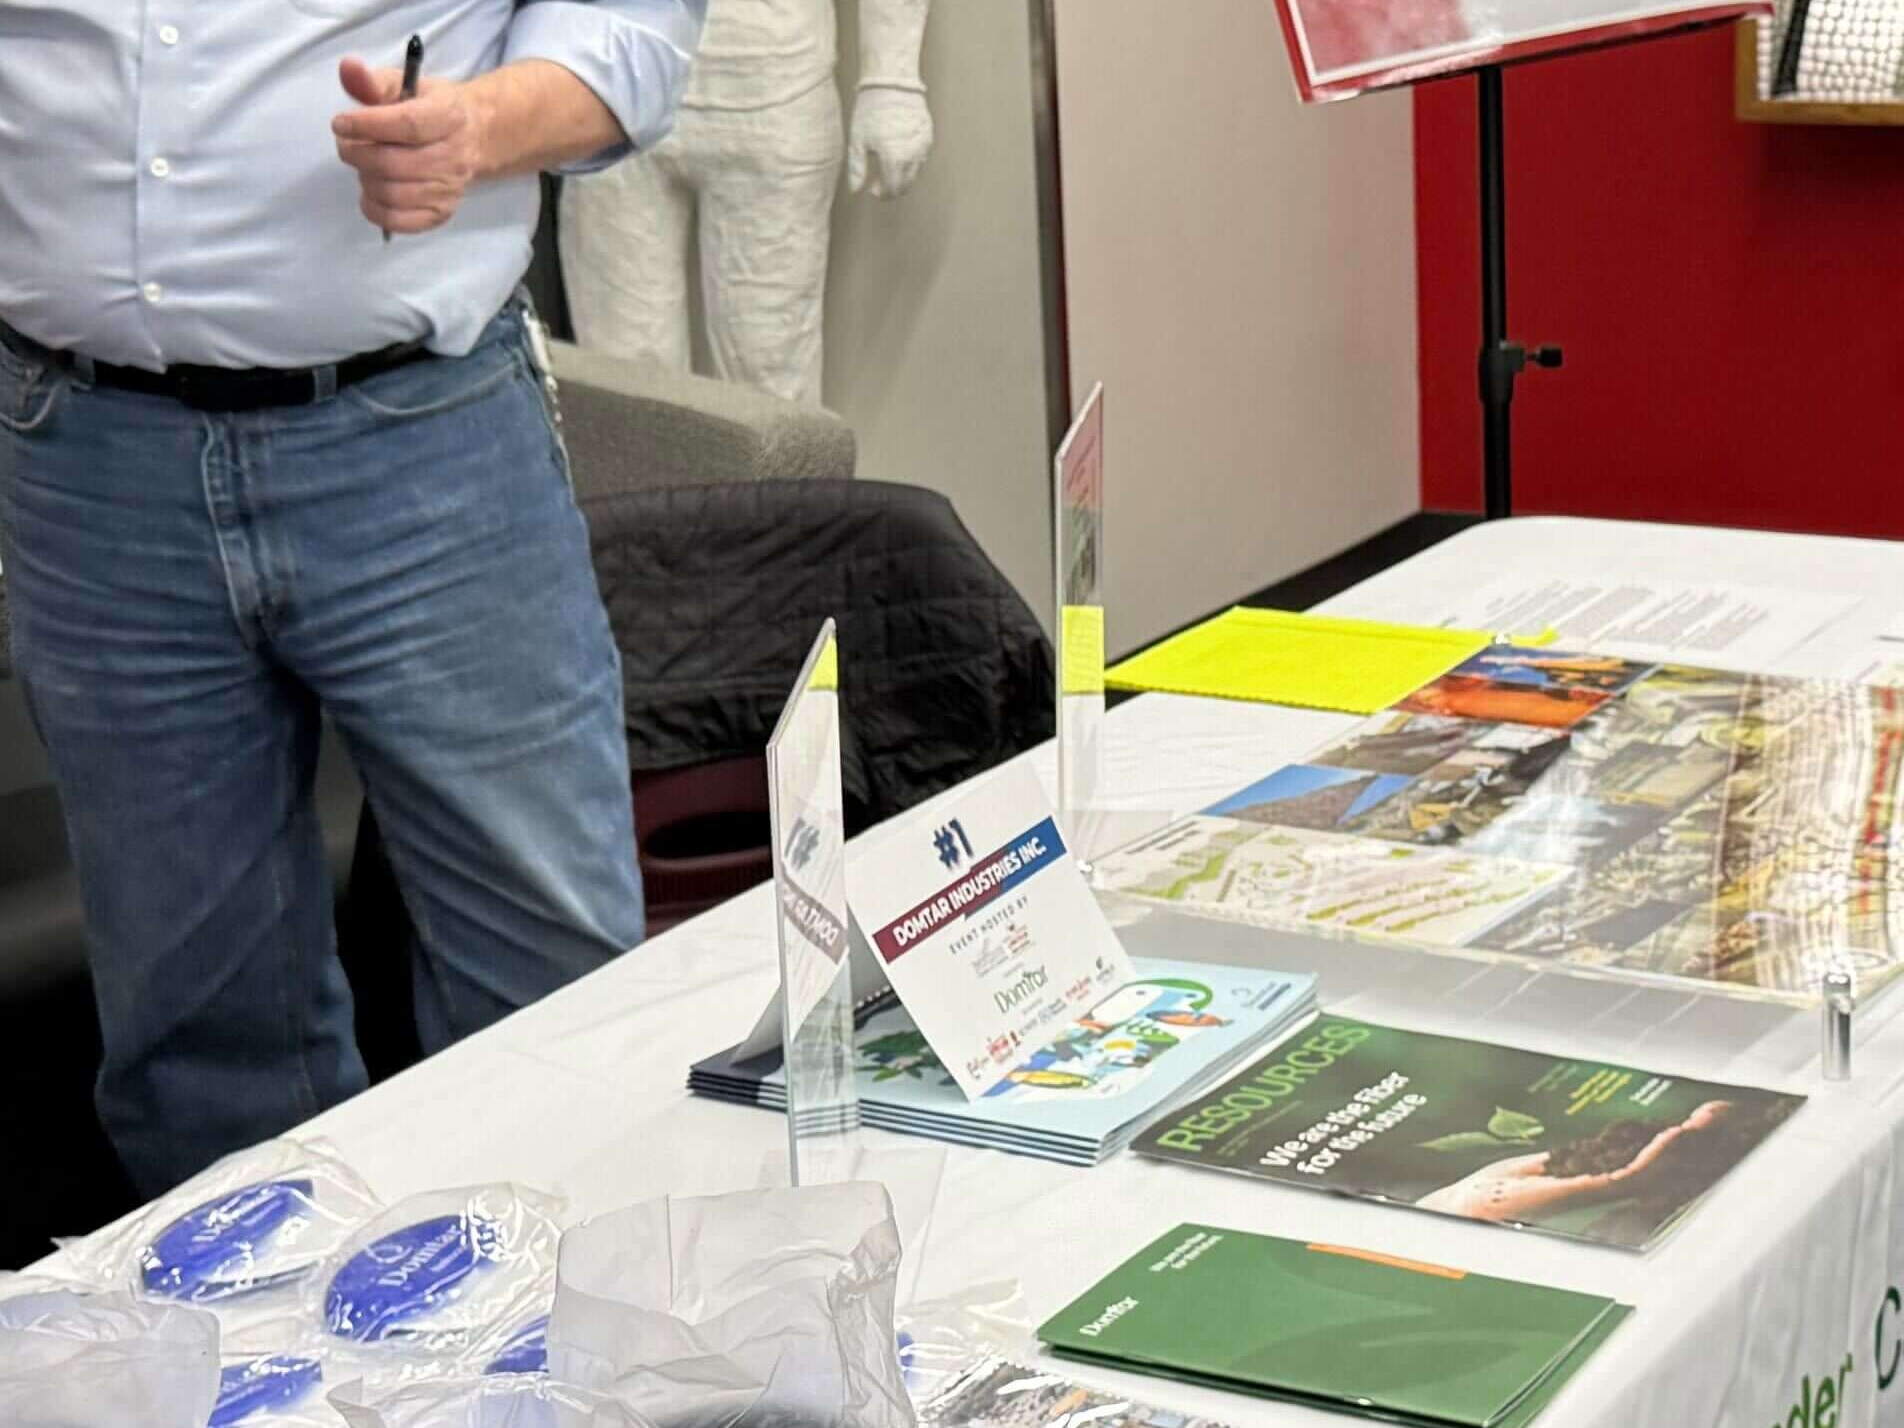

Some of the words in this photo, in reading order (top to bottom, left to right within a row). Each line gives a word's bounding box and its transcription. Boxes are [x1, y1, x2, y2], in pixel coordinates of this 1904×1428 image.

[932, 817, 974, 870] #1
[893, 897, 951, 948] DOMTAR
[950, 851, 1022, 913] INDUSTRIES
[1018, 836, 1048, 866] INC.
[994, 962, 1049, 1015] Domtar
[1156, 1023, 1373, 1154] RESOURCES
[1296, 1149, 1343, 1176] for
